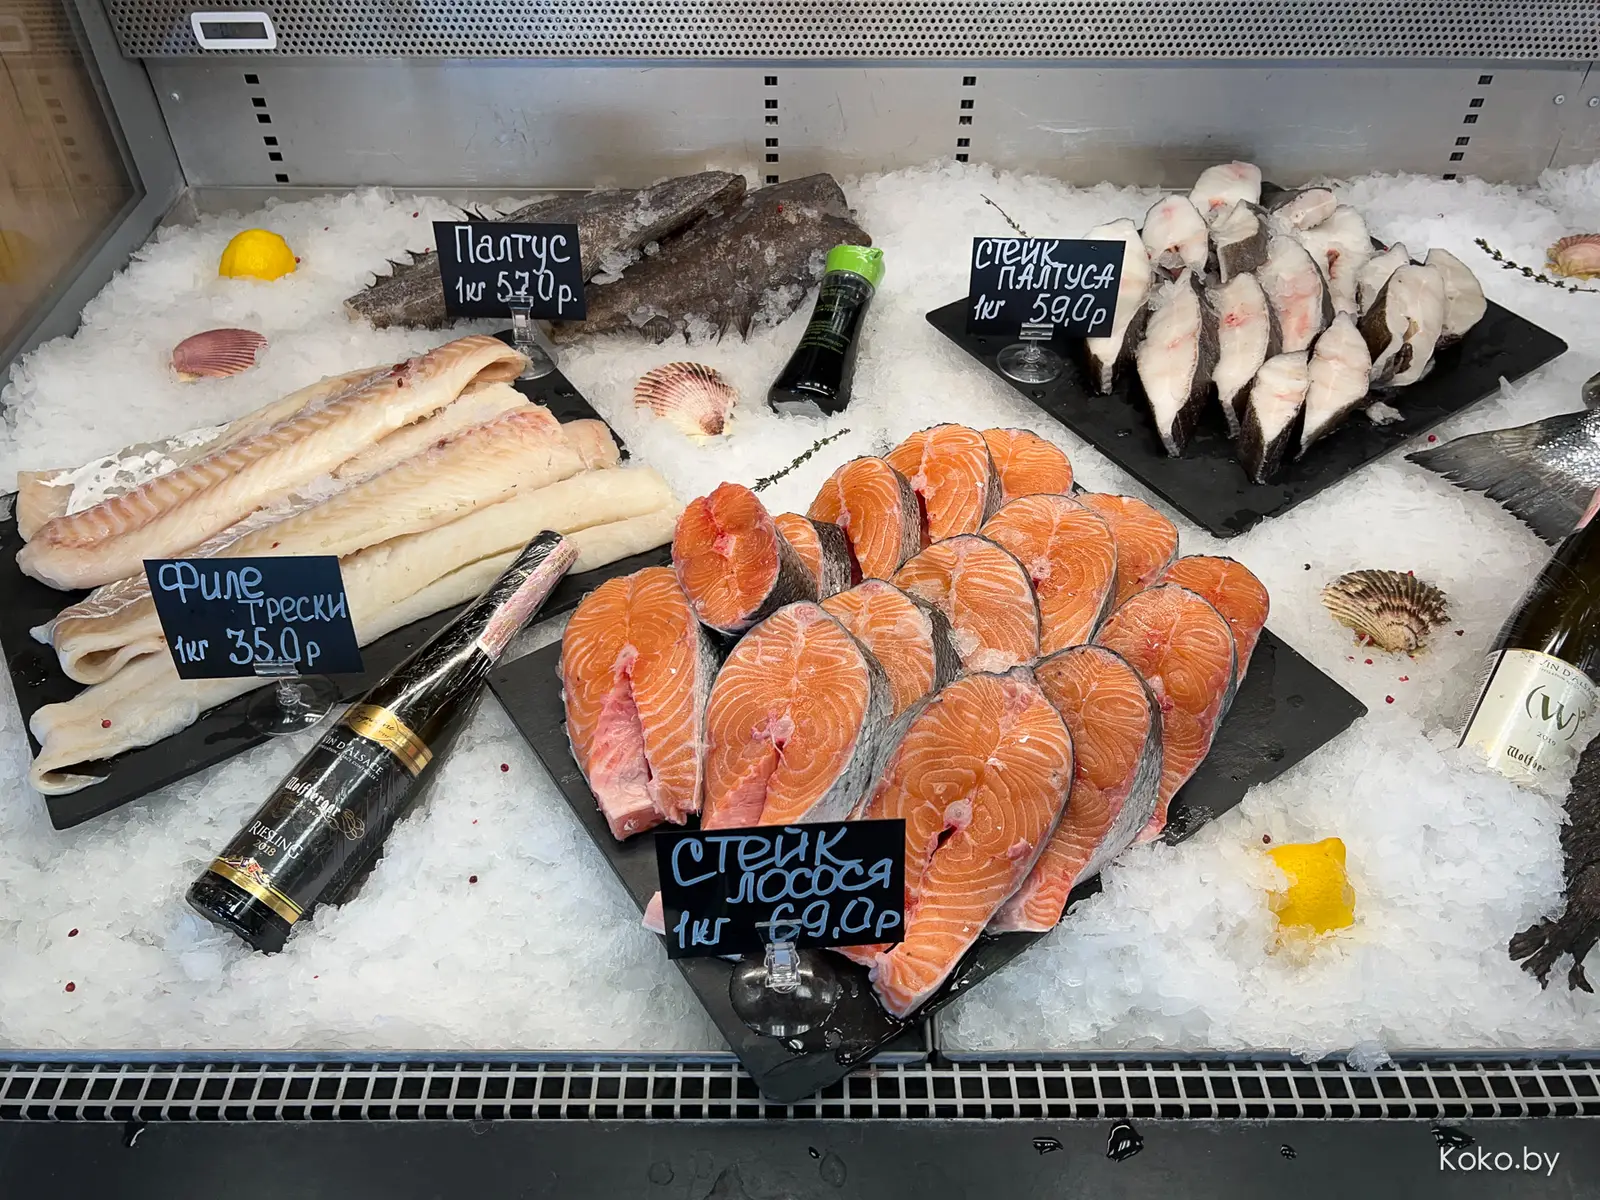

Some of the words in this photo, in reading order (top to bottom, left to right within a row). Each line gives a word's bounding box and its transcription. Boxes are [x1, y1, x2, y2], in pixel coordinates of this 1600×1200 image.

[454, 225, 571, 275] Палтус
[455, 276, 486, 304] 1кг
[997, 263, 1115, 290] ПАЛТУСА
[973, 293, 1006, 321] 1кг
[158, 561, 265, 604] Филе
[174, 635, 209, 664] 1кг
[249, 820, 303, 859] RIESLING
[253, 839, 276, 857] 2018
[673, 910, 731, 949] 1кг
